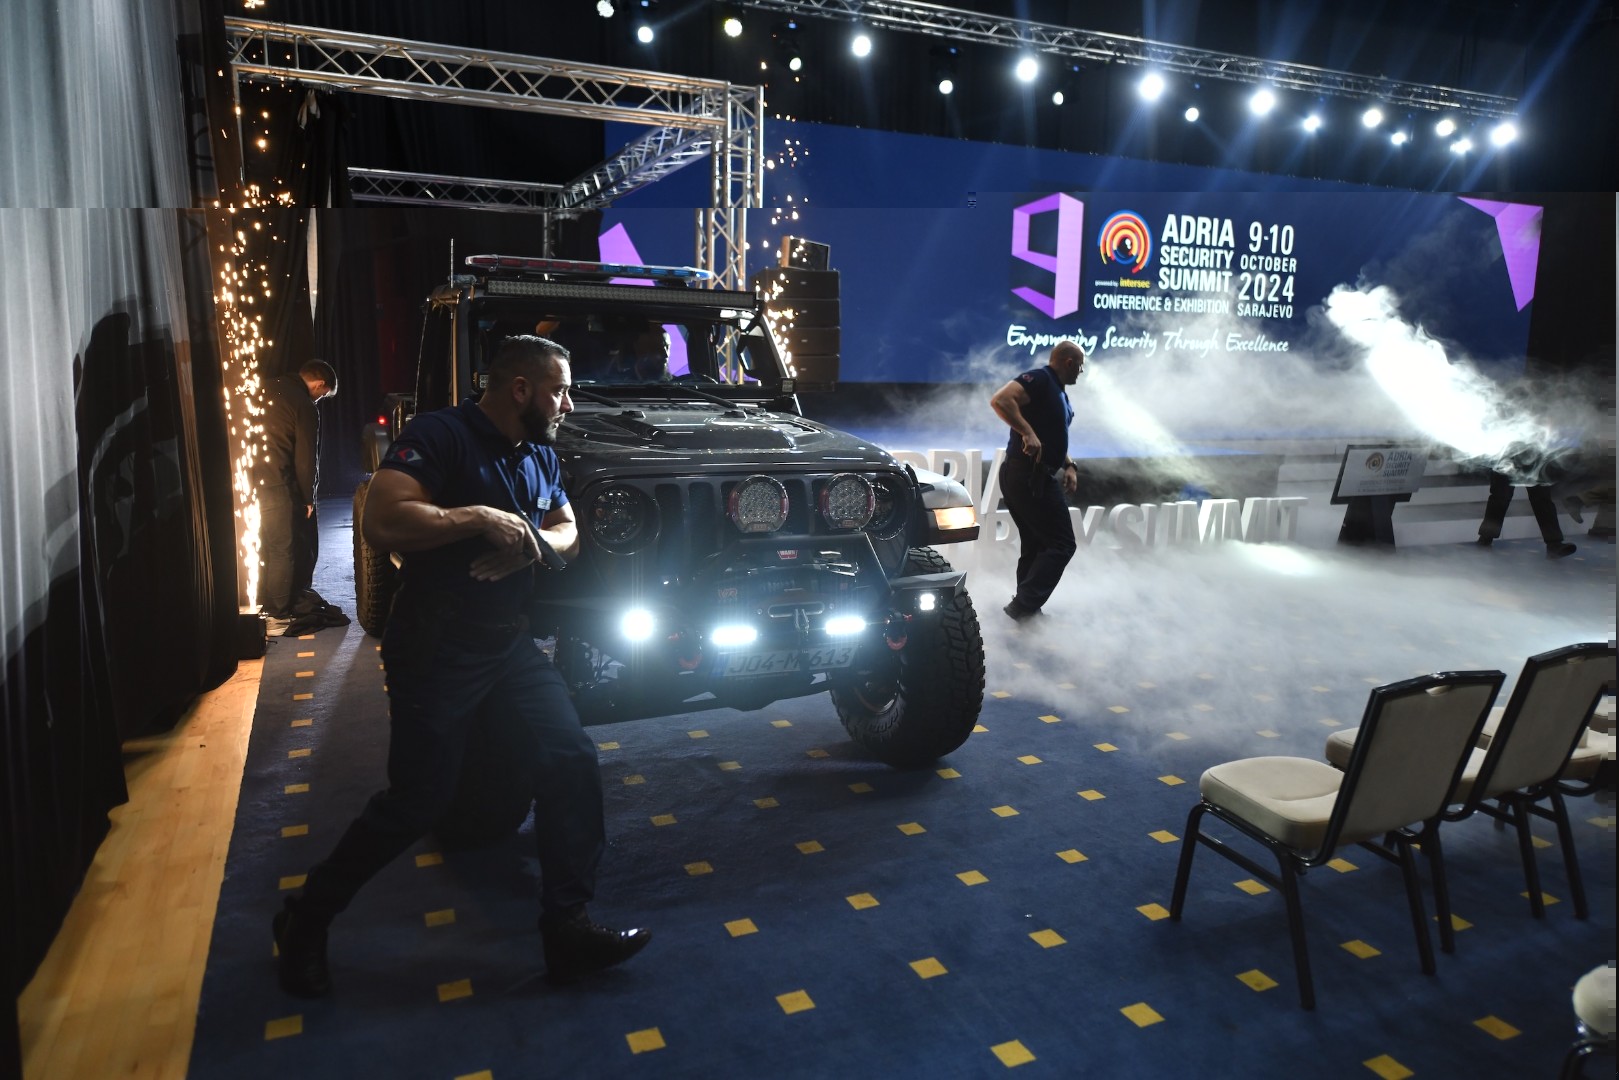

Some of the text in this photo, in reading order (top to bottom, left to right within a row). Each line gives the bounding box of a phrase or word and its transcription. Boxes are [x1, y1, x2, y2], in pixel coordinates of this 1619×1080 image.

[1161, 213, 1235, 248] ADRIA
[1160, 244, 1234, 269] SECURITY
[1240, 254, 1297, 273] OCTOBER
[1119, 277, 1151, 289] intersec
[1158, 266, 1233, 293] SUMMIT
[1238, 272, 1295, 302] 2024
[1093, 293, 1230, 314] CONFERENCE & EXHIBITION
[1237, 302, 1293, 319] SARAJEVO
[1102, 325, 1158, 358] Security
[1163, 327, 1220, 358] Through
[1225, 332, 1289, 352] Excellence
[1387, 451, 1412, 461] ADRIA
[1382, 468, 1409, 477] SUMMIT
[1109, 497, 1309, 547] SUMMIT
